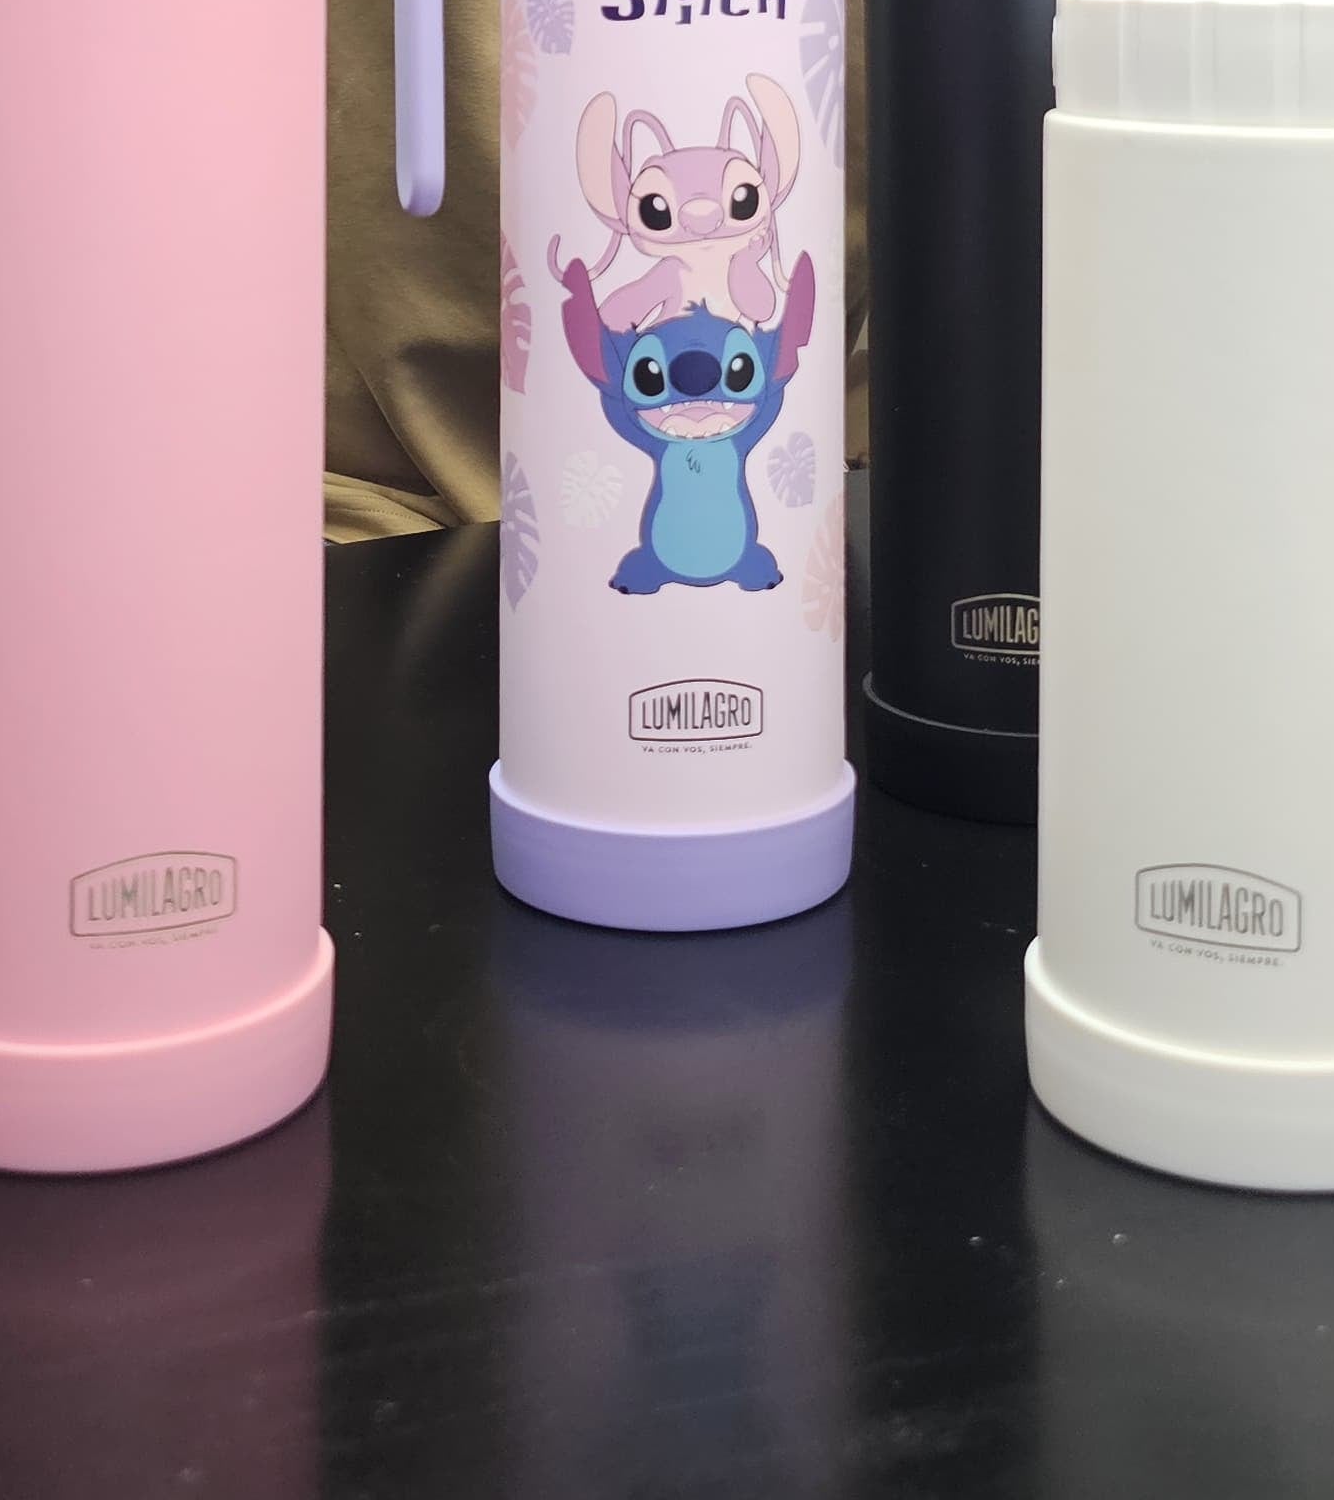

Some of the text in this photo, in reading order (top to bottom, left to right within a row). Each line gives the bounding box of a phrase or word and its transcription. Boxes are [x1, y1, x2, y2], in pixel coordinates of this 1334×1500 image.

[962, 604, 1040, 645] LUMILAG
[641, 691, 752, 731] LUMILAGRO
[641, 745, 655, 754] YA
[658, 745, 680, 754] CON
[87, 865, 223, 922] LUMILAGRO
[1150, 879, 1285, 938] LUMILAGRO
[1168, 943, 1193, 956] CON
